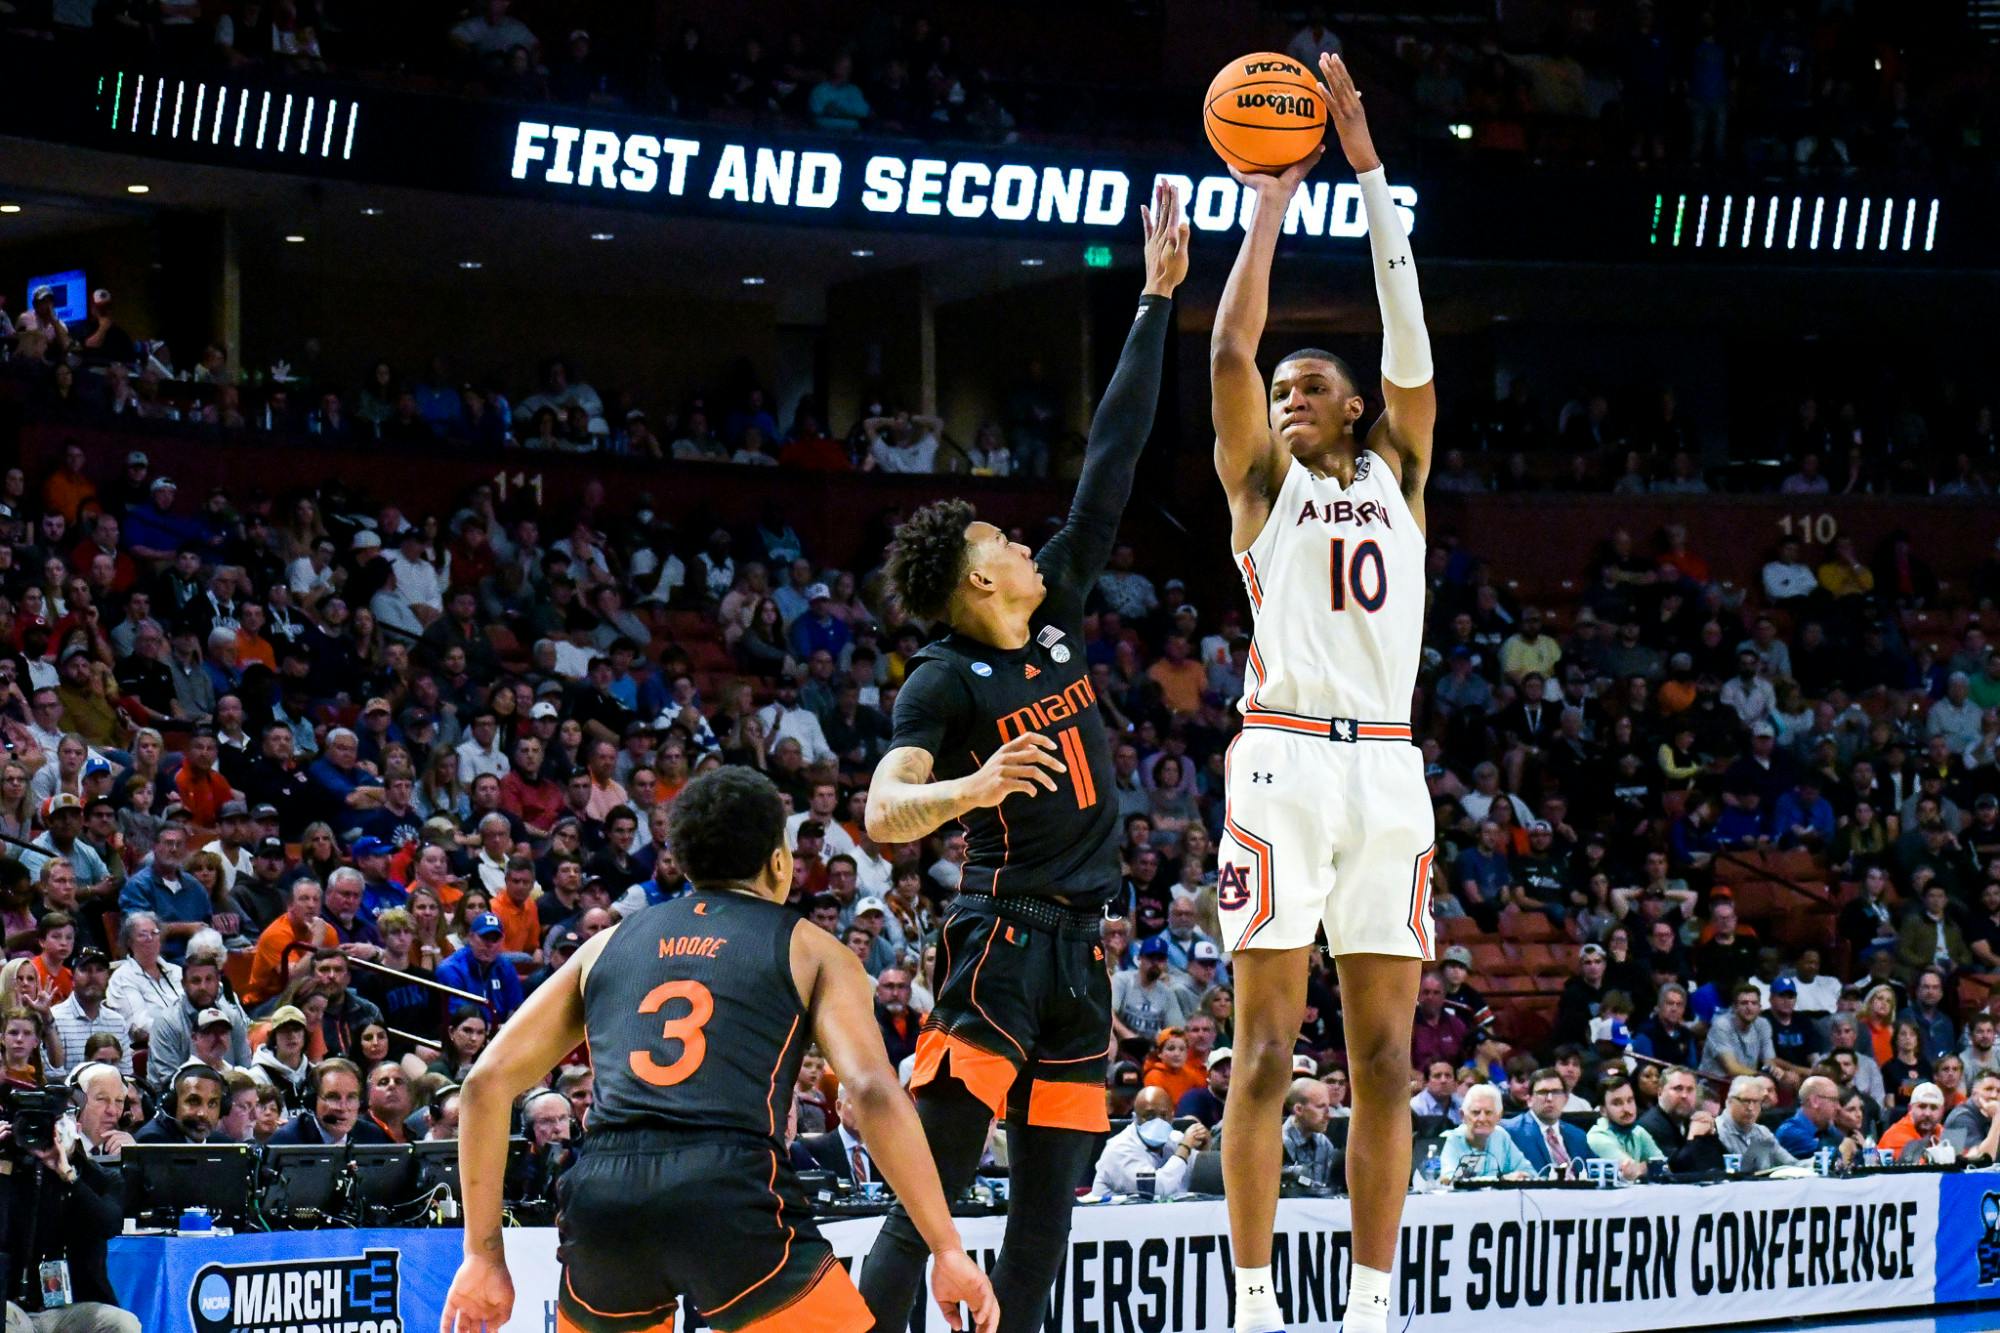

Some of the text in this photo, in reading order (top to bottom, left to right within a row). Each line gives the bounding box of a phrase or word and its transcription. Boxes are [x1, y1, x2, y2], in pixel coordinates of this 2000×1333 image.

[1245, 61, 1302, 76] NCAA
[1237, 94, 1314, 118] Wilson
[512, 122, 699, 195] FIRST
[709, 145, 841, 208] AND
[862, 156, 1129, 225] SECOND
[1778, 513, 1837, 544] 110
[1330, 538, 1388, 613] 10
[1058, 726, 1097, 810] 11
[659, 936, 727, 958] MOORE
[630, 980, 714, 1086] 3
[1272, 1231, 1352, 1324] AND
[1400, 1224, 1454, 1316] HE
[1466, 1214, 1680, 1311] SOUTHERN
[1691, 1201, 1917, 1296] CONFERENCE
[234, 1269, 342, 1325] MARCH
